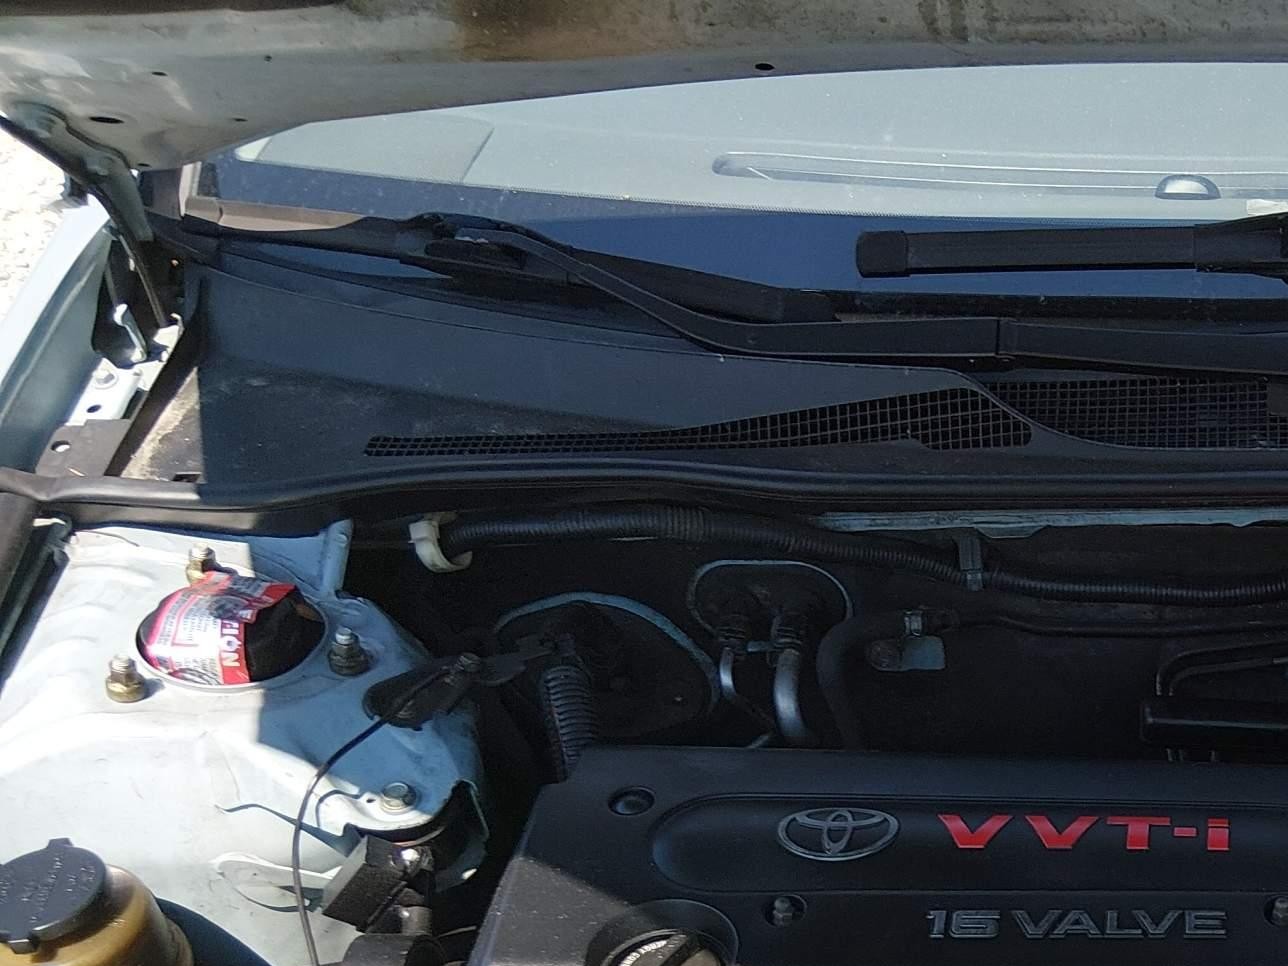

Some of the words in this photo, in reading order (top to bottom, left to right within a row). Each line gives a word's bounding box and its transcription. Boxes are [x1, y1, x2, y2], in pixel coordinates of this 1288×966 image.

[937, 812, 1231, 851] VVT-i
[925, 908, 1001, 939] 16
[1012, 908, 1228, 939] VALVE
